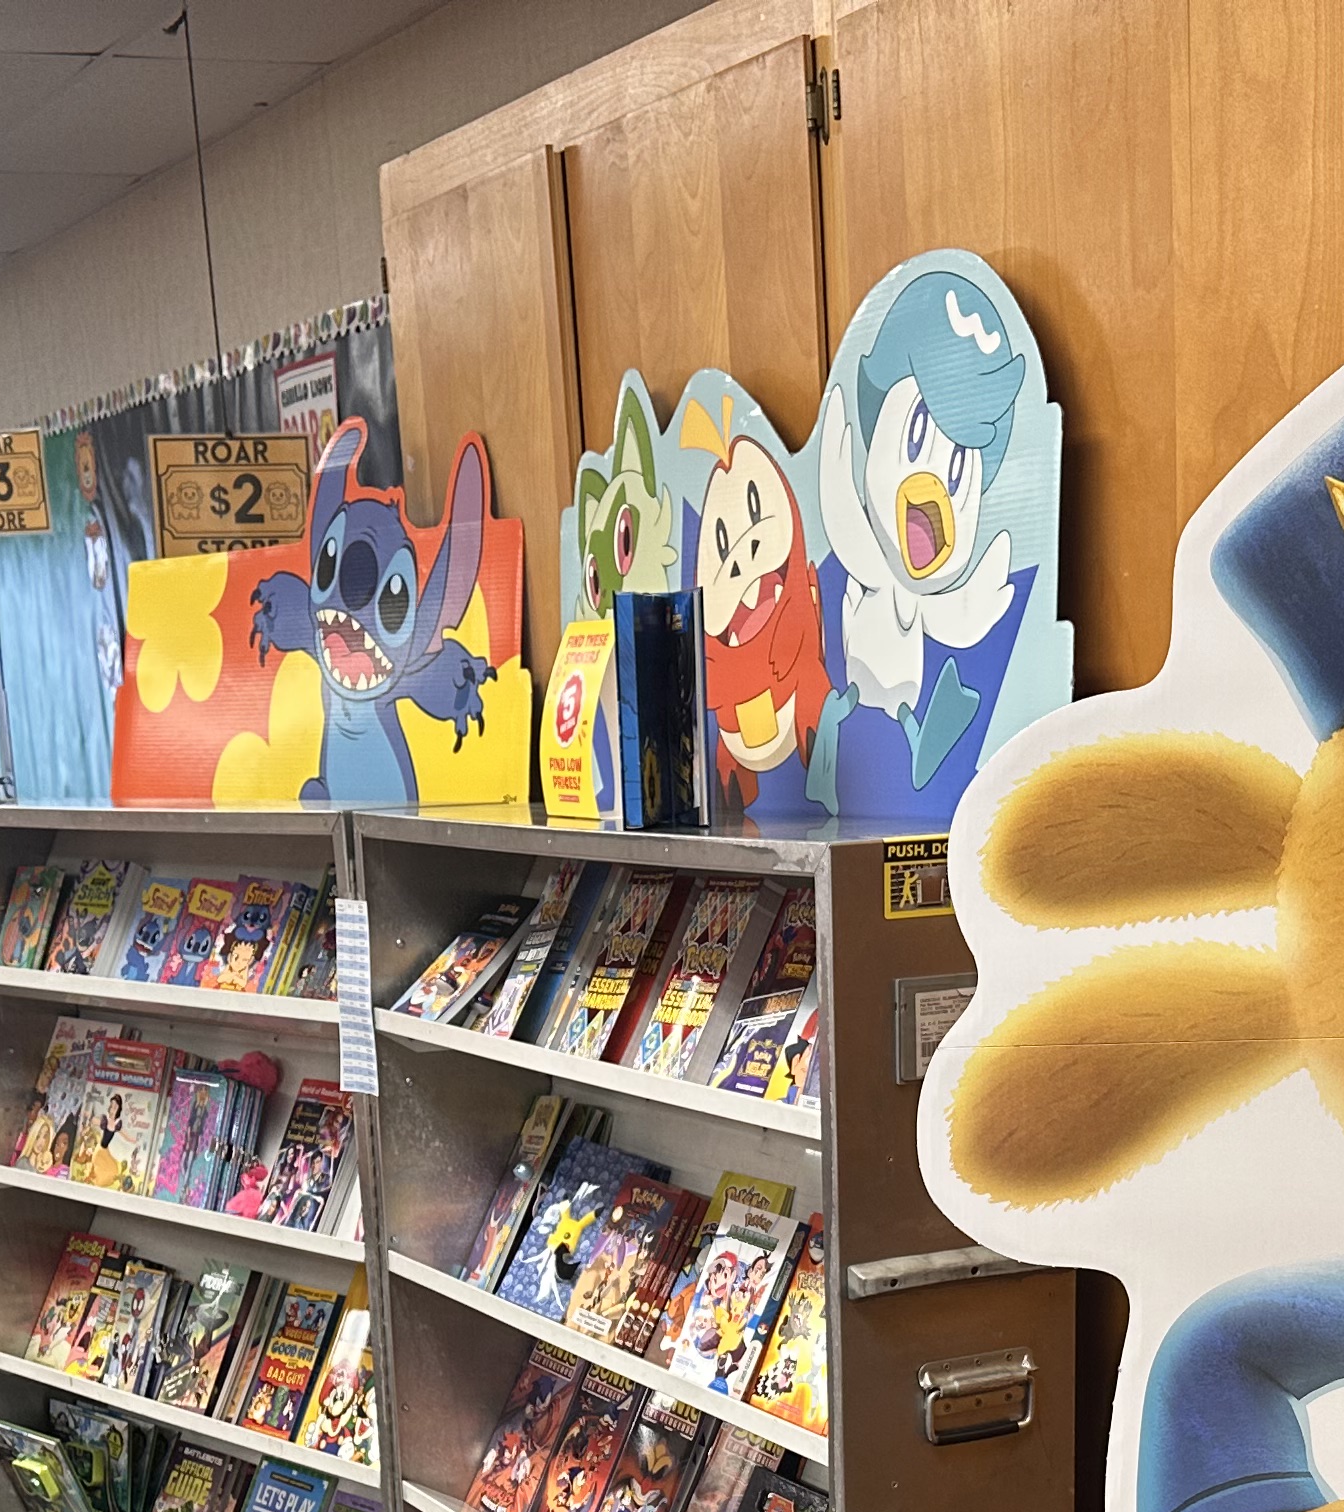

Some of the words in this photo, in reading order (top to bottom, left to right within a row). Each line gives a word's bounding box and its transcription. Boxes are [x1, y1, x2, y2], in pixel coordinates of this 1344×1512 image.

[194, 440, 269, 464] ROAR
[210, 473, 266, 524] $2
[566, 635, 585, 648] FIND
[587, 633, 609, 646] THESE
[562, 684, 576, 720] 5
[549, 757, 565, 771] FIND
[567, 756, 582, 772] LOW
[553, 775, 581, 790] PRICES!
[887, 843, 929, 858] PUSH,
[267, 1366, 285, 1381] BAD
[286, 1372, 305, 1386] GUYS
[184, 1447, 223, 1467] BATTLEBOTS
[181, 1459, 214, 1481] OFFICIAL
[163, 1474, 214, 1506] GUIDE
[257, 1482, 287, 1511] LET'S
